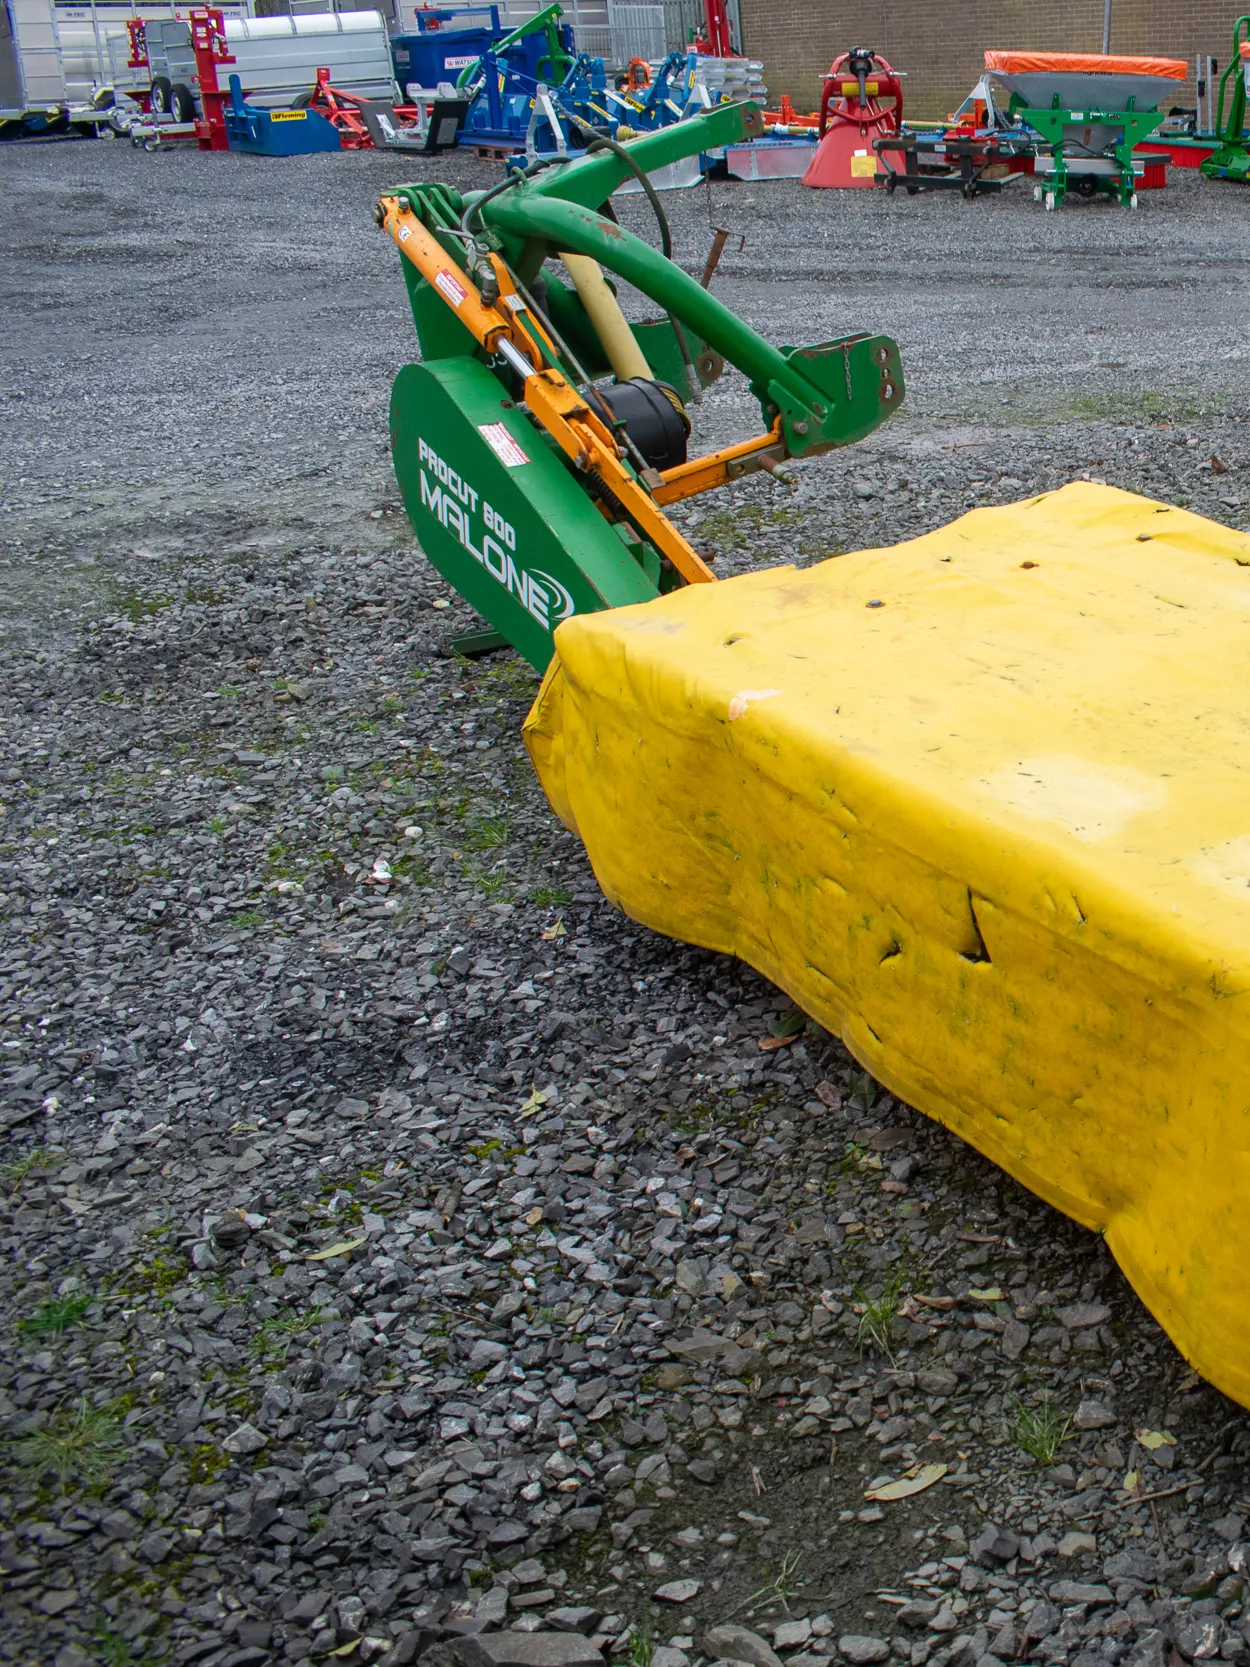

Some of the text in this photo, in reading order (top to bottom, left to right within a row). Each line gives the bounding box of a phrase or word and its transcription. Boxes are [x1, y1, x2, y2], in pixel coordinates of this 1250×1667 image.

[277, 111, 306, 119] Fleming
[418, 437, 479, 513] PROCUT
[483, 501, 516, 551] 800
[420, 468, 550, 631] MALONE
